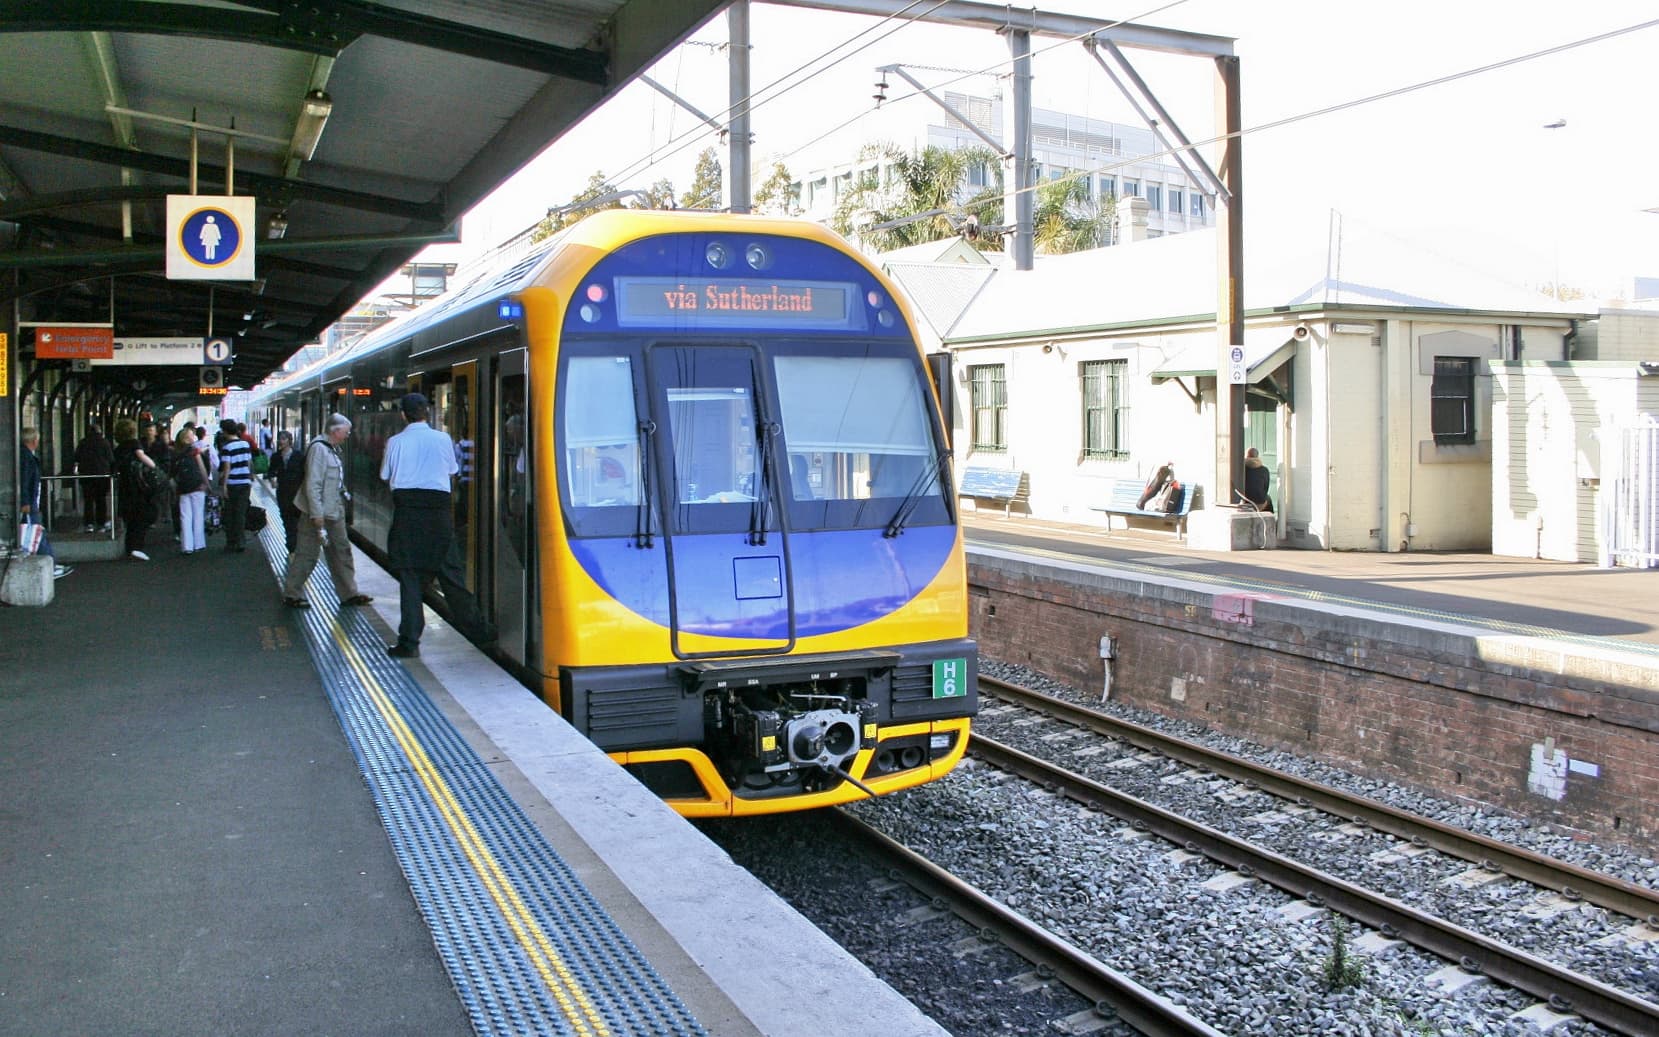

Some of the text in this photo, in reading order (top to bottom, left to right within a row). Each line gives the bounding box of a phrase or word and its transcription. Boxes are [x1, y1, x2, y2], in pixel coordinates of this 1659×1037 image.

[664, 284, 813, 312] via Sutherland
[55, 335, 110, 344] Emergency
[81, 345, 107, 353] Point
[212, 343, 221, 358] 1
[943, 662, 956, 678] H
[943, 679, 956, 696] 6
